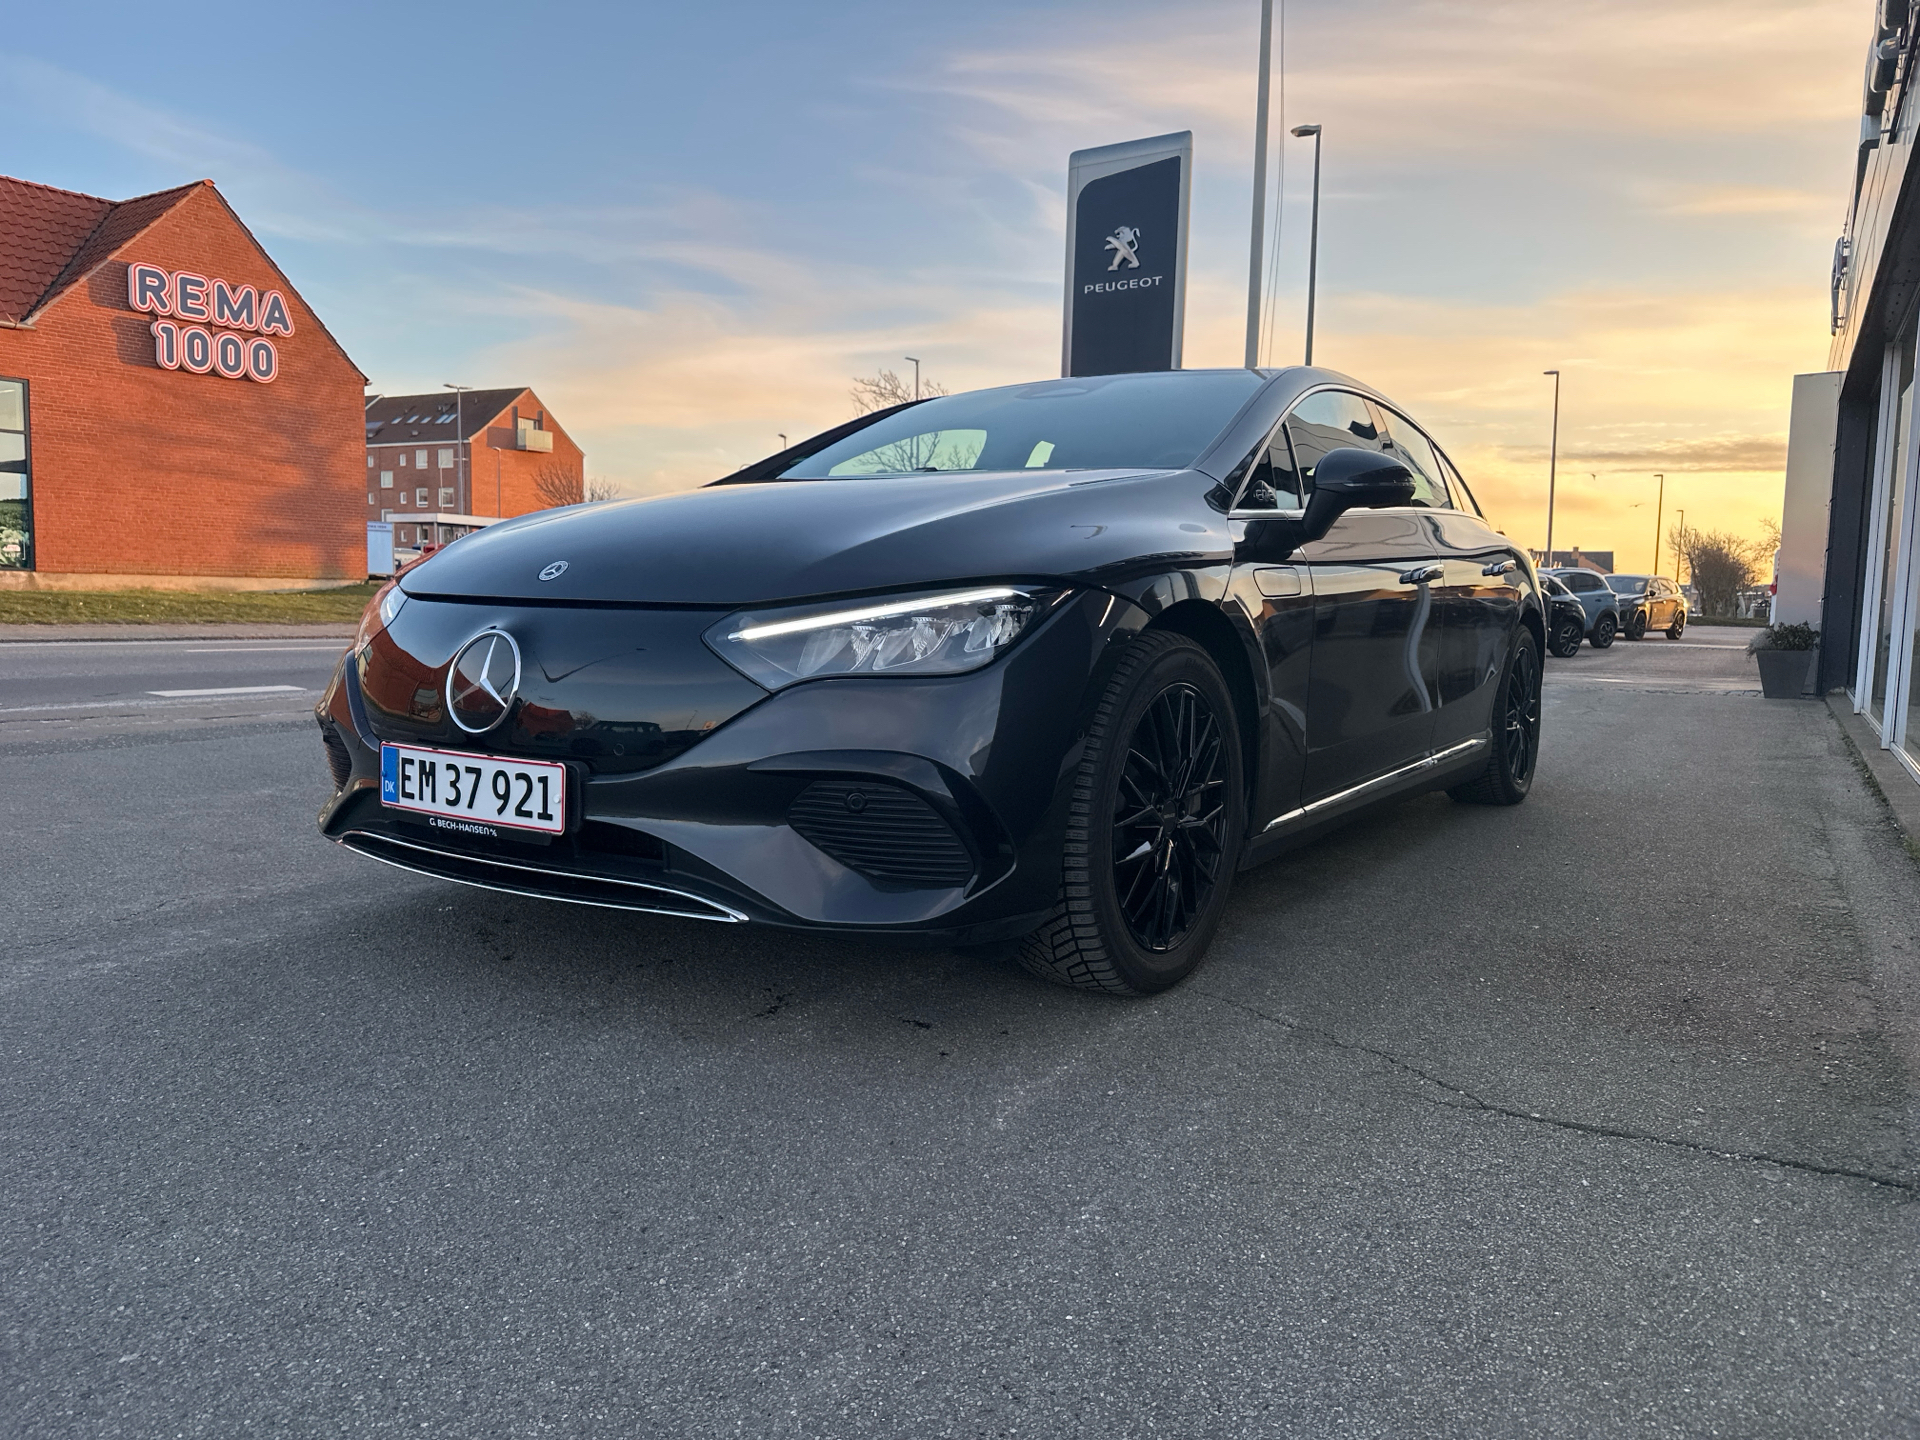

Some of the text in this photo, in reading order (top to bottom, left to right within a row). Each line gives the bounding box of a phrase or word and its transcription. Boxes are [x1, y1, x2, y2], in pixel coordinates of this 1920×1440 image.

[130, 262, 295, 337] REMA
[1084, 276, 1163, 294] PEUGEOT
[151, 320, 279, 383] 1000
[384, 780, 395, 794] DK
[401, 757, 553, 822] EM 37 921
